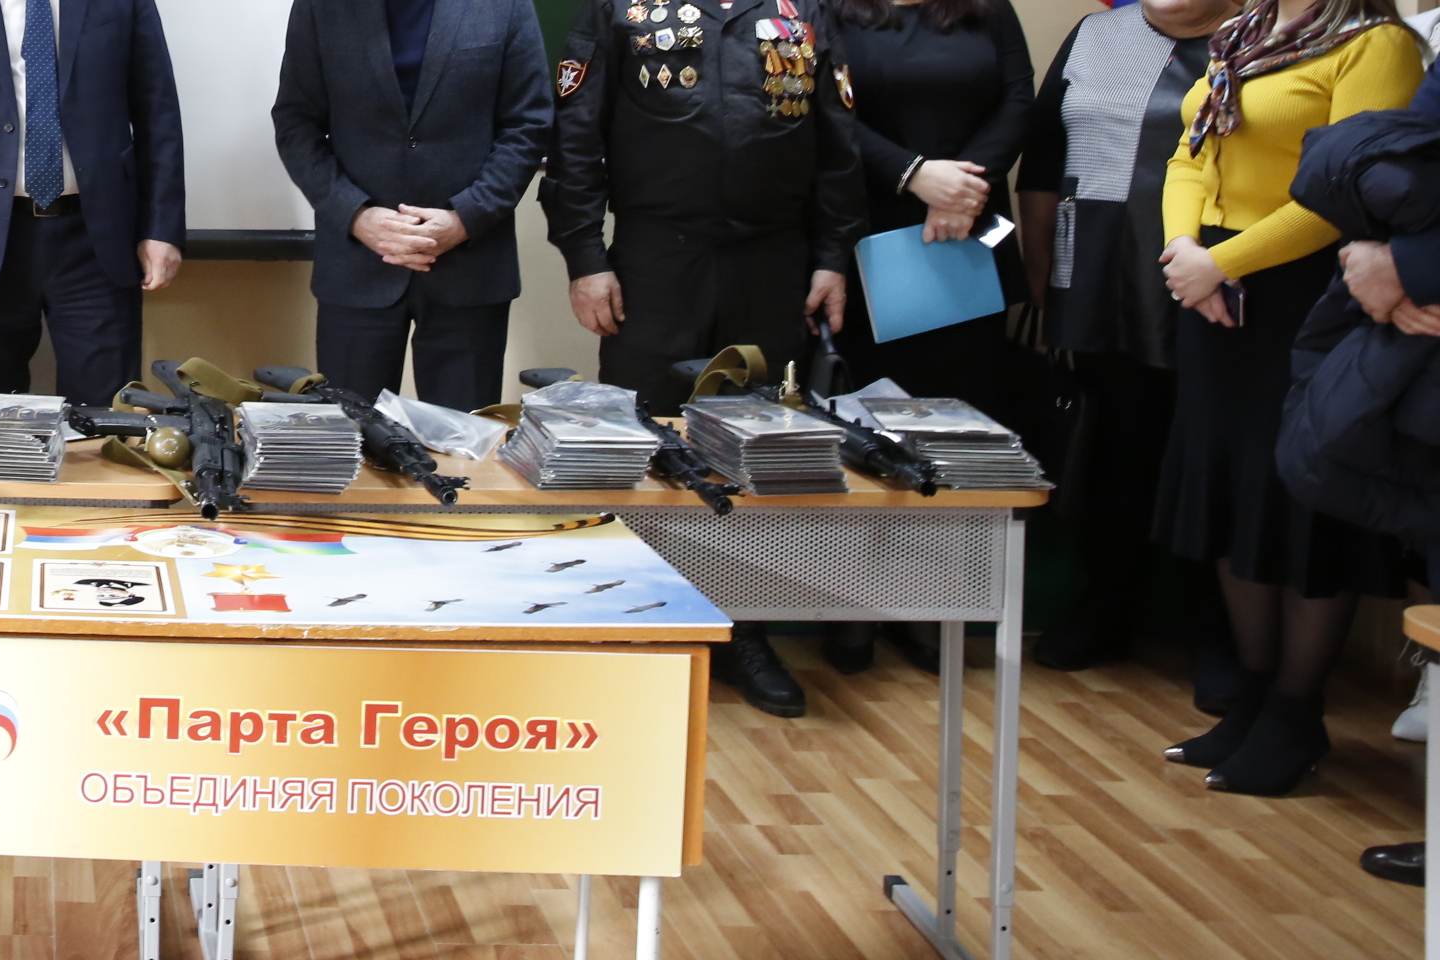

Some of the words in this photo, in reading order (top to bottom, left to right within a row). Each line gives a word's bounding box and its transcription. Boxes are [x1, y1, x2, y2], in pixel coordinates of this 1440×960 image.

[96, 696, 336, 754] «Парта
[362, 702, 599, 759] Героя»
[80, 772, 336, 815] ОБЪЕДИНЯЯ
[348, 779, 601, 819] ПОКОЛЕНИЯ
